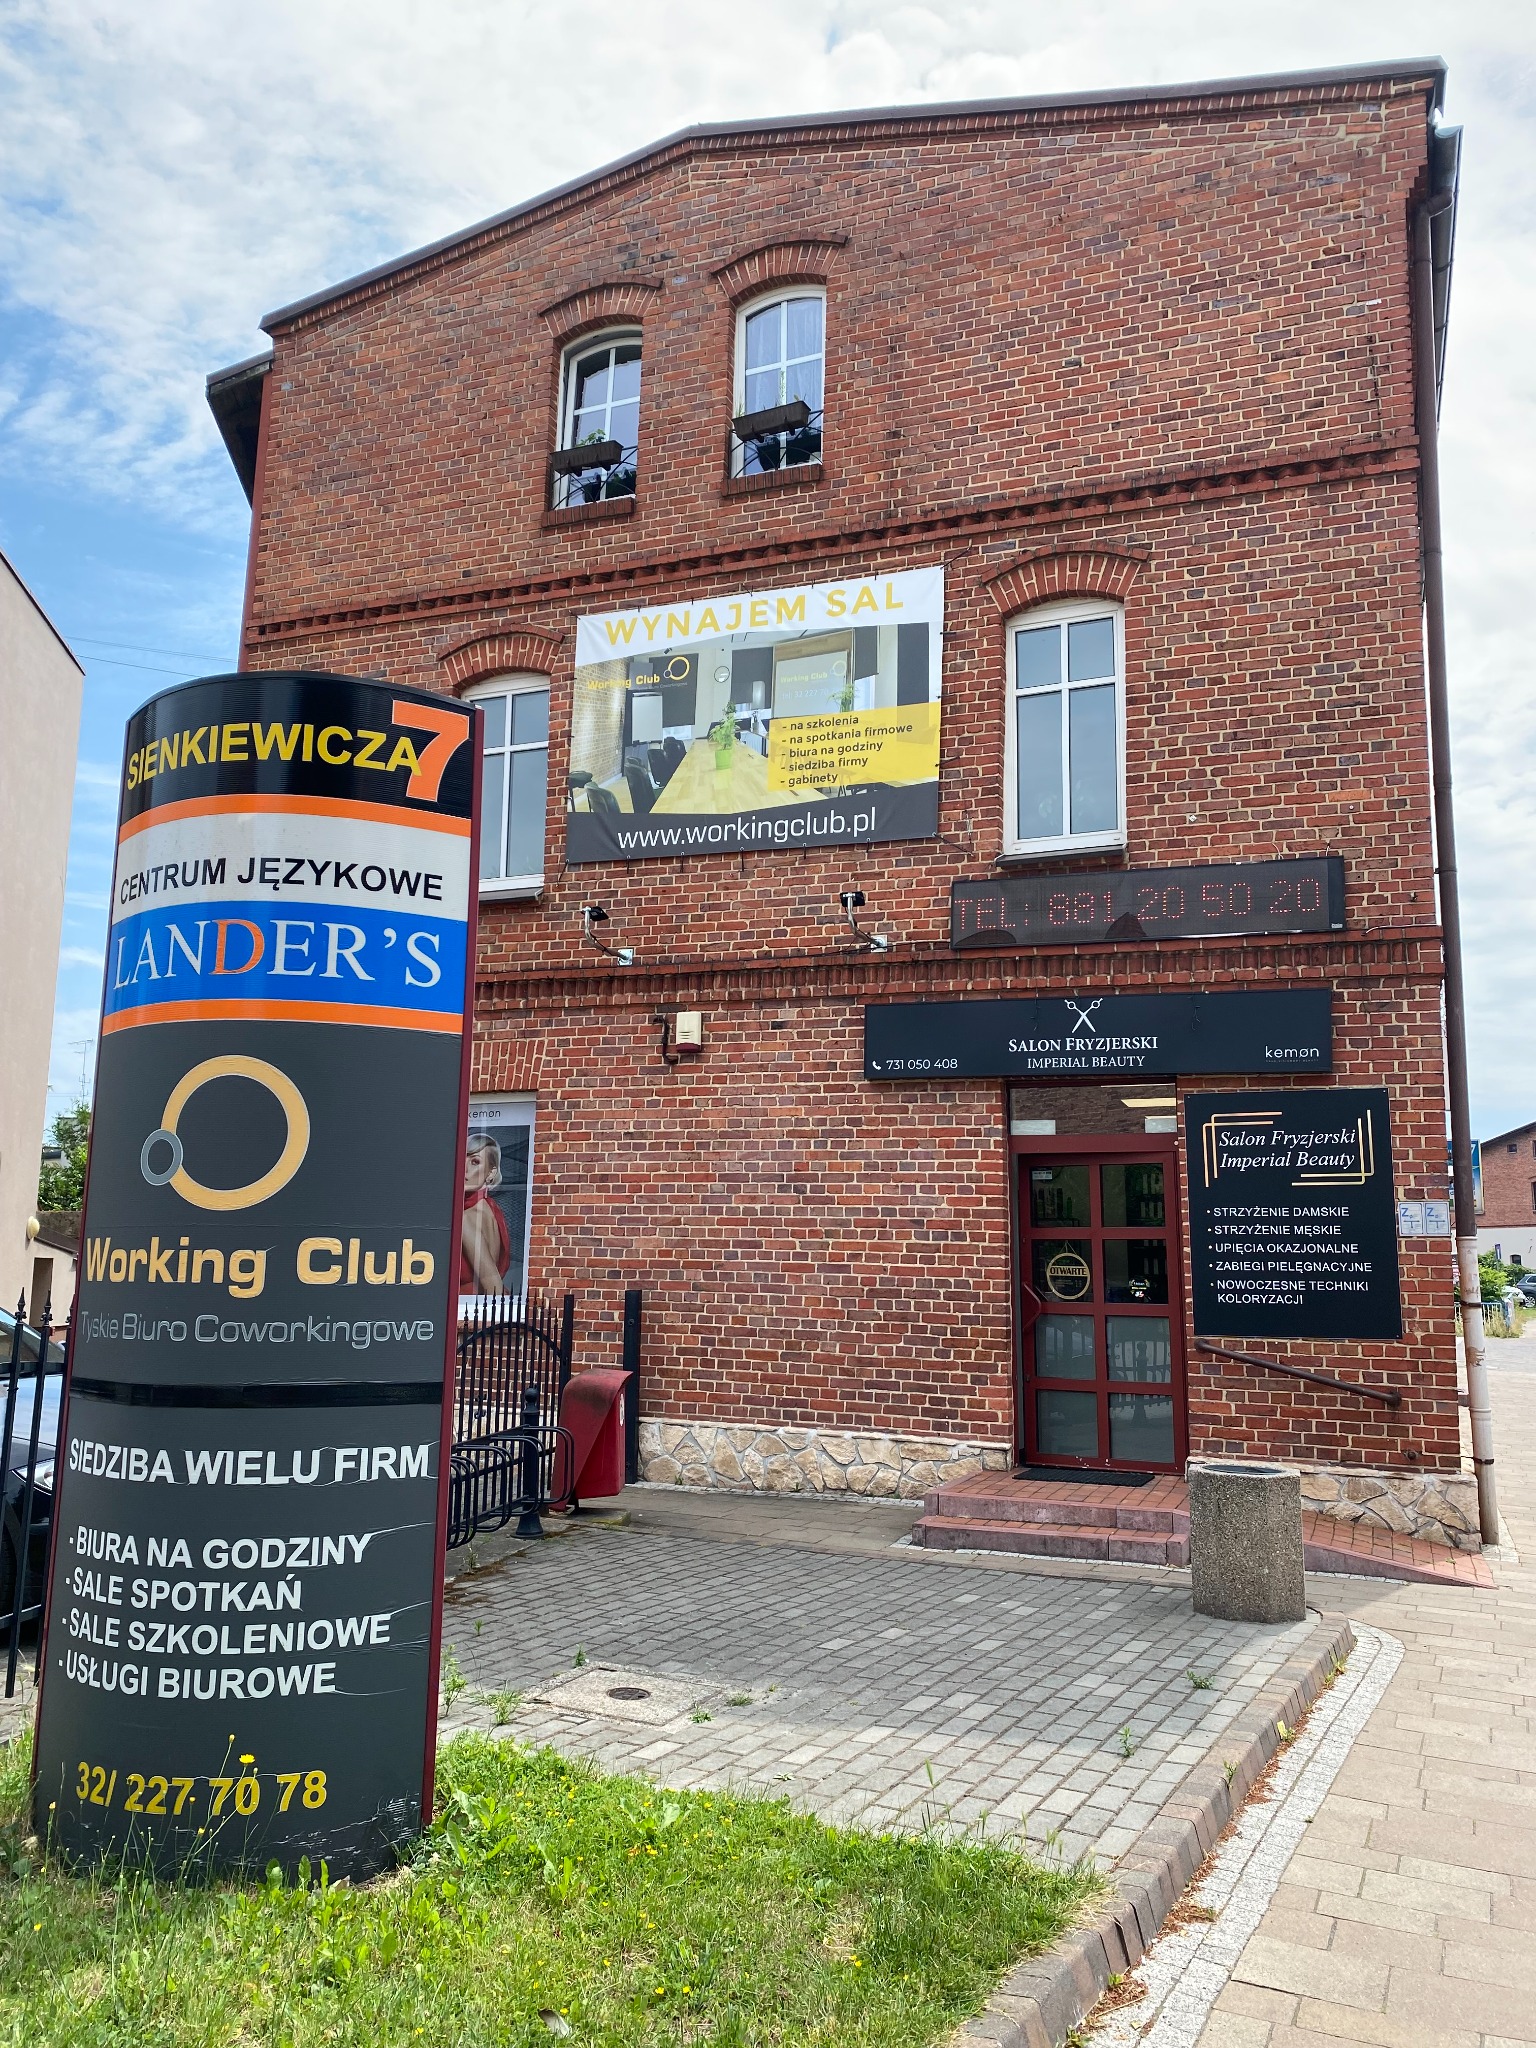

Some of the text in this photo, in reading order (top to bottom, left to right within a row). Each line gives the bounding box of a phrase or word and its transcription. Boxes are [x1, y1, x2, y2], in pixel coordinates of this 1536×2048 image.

[605, 582, 904, 646] WYNAJEM SAL
[635, 673, 661, 685] Club
[790, 716, 859, 731] na szkolenia
[789, 724, 913, 747] na spotkania firmowe
[127, 700, 470, 802] SIENKIEWICZA 7
[789, 741, 883, 758] biura na godziny
[788, 757, 868, 772] siedziba firmy
[788, 773, 838, 787] gabinety
[617, 806, 877, 849] www.workingclub.pl
[120, 857, 443, 905] CENTRUM JĘZYKOWE
[1136, 886, 1185, 920] 20
[1202, 882, 1251, 917] 50
[1268, 878, 1320, 915] 20
[113, 918, 442, 989] LANDER’S
[1008, 1036, 1159, 1053] SALON FRYZJERSKI
[886, 1058, 958, 1070] 731 050 408
[1027, 1055, 1146, 1069] IMPERIAL BEAUTY
[1218, 1128, 1356, 1149] Salon Fryzjerski
[1219, 1151, 1355, 1172] Imperial Beauty
[1213, 1205, 1350, 1217] STRZYŻENIE DAMSKIE
[1214, 1223, 1342, 1237] STRZYŻENIE MĘSKIE
[1215, 1243, 1359, 1255] UPIĘCIA OKAZJONALNE
[86, 1236, 435, 1298] Working Club
[1050, 1267, 1087, 1276] OTWARTE
[1215, 1261, 1372, 1274] ZABIEGI PIELĘGNACYJNE
[1217, 1280, 1369, 1291] NOWOCZESNE TECHNIKI
[1217, 1294, 1303, 1305] KOLORYZACJI
[81, 1311, 434, 1350] Tyskie Biuro Coworkingowe
[69, 1437, 429, 1485] SIEDZIBA WIELU FIRM
[76, 1525, 372, 1570] BIURA NA GODZINY
[72, 1566, 302, 1612] SALE SPOTKAŃ
[69, 1607, 391, 1655] SALE SZKOLENIOWE
[66, 1649, 336, 1700] USŁUGI BIUROWE
[76, 1761, 327, 1816] 32/ 227 70 78
